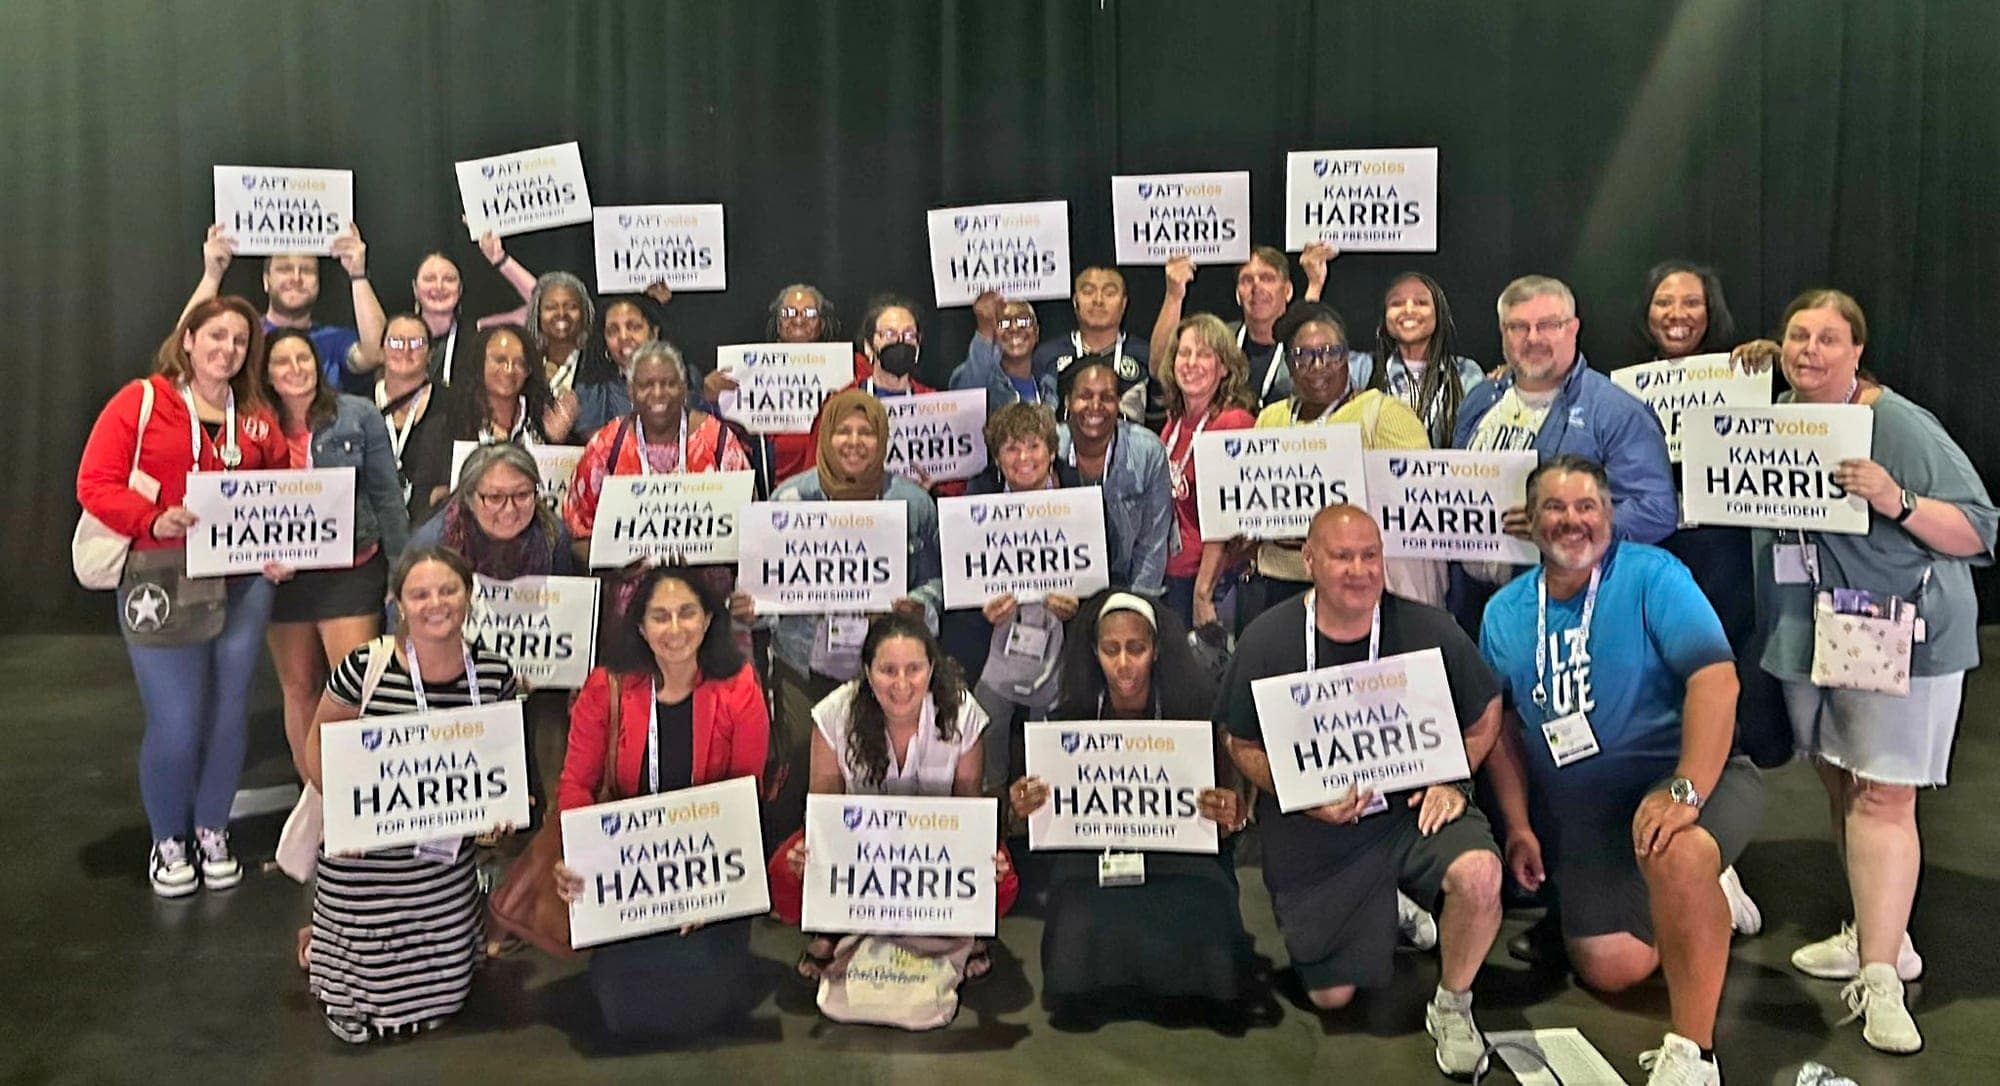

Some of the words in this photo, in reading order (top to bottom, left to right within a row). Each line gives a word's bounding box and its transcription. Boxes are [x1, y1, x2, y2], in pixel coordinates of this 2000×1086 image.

[1331, 159, 1405, 176] AFTvotes
[259, 176, 326, 190] AFTvotes
[496, 175, 554, 196] KAMALA
[1156, 183, 1222, 198] AFTvotes
[1324, 183, 1398, 200] KAMALA
[253, 196, 321, 210] KAMALA
[482, 182, 576, 218] HARRIS
[235, 210, 339, 235] HARRIS
[1150, 204, 1217, 221] KAMALA
[1305, 200, 1420, 226] HARRIS
[1133, 217, 1237, 243] HARRIS
[1318, 230, 1339, 242] FOR
[1342, 230, 1401, 242] PRESIDENT
[250, 236, 270, 247] FOR
[273, 236, 325, 247] PRESIDENT
[630, 234, 694, 248] KAMALA
[967, 236, 1036, 255] KAMALA
[1147, 245, 1167, 257] FOR
[1168, 244, 1222, 257] PRESIDENT
[614, 246, 712, 271] HARRIS
[950, 250, 1056, 282] HARRIS
[761, 351, 826, 366] AFTvotes
[755, 373, 821, 387] KAMALA
[1653, 365, 1735, 386] AFTvotes
[737, 388, 823, 411] HARRI
[888, 401, 959, 417] AFTvotes
[751, 414, 770, 425] FOR
[1736, 417, 1829, 436] AFTvotes
[893, 421, 952, 439] AMALA
[887, 433, 973, 463] ARRIS
[1247, 438, 1328, 454] AFTvotes
[1729, 446, 1821, 467] KAMALA
[1240, 463, 1322, 483] KAMALA
[1411, 460, 1501, 478] AFTvotes
[243, 480, 323, 496] AFTvotes
[650, 482, 723, 496] AFTvotes
[1706, 466, 1848, 500] HARRIS
[1404, 487, 1494, 505] KAMALA
[234, 503, 316, 521] KAMALA
[639, 501, 713, 516] KAMALA
[992, 503, 1071, 520] AFTvotes
[1727, 501, 1753, 514] FOR
[1756, 503, 1828, 518] PRESIDENT
[614, 514, 733, 541] HARRIS
[794, 512, 874, 529] AFTvotes
[1238, 516, 1262, 529] FOR
[1382, 505, 1498, 535] HARRI
[211, 518, 338, 548] HARRIS
[986, 527, 1067, 548] KAMALA
[628, 543, 650, 556] FOR
[654, 542, 714, 555] PRESIDENT
[786, 538, 867, 556] KAMALA
[1402, 537, 1427, 550] FOR
[1430, 538, 1501, 552] PRESIDENT
[228, 552, 252, 563] FOR
[256, 548, 319, 561] PRESIDENT
[965, 544, 1091, 579] HARRIS
[762, 556, 890, 585] HARRIS
[478, 585, 561, 603] AFTvotes
[985, 580, 1008, 594] FOR
[1011, 576, 1073, 591] PRESIDENT
[780, 590, 804, 602] FOR
[807, 589, 871, 602] PRESIDENT
[472, 630, 573, 659] ARRIS
[1316, 671, 1408, 702] AFTvotes
[1313, 702, 1409, 734] KAMALA
[388, 721, 485, 747] AFTvotes
[1084, 732, 1176, 752] AFTvotes
[1293, 716, 1442, 774] HARRIS
[380, 751, 478, 781] KAMALA
[1078, 763, 1170, 784] KAMALA
[1322, 773, 1350, 789] FOR
[1353, 759, 1425, 783] PRESIDENT
[353, 766, 508, 818] HARRIS
[1054, 785, 1198, 818] HARRIS
[376, 818, 407, 836] FOR
[410, 808, 486, 831] PRESIDENT
[626, 801, 721, 833] AFTvotes
[867, 809, 960, 831] AFTvotes
[1074, 822, 1100, 836] FOR
[1103, 822, 1177, 838] PRESIDENT
[620, 831, 715, 865] KAMALA
[857, 841, 950, 864] KAMALA
[596, 848, 746, 906] HARRIS
[829, 863, 977, 899] HARRIS
[619, 905, 648, 922] FOR
[651, 891, 726, 917] PRESIDENT
[849, 904, 876, 920] FOR
[880, 904, 953, 921] PRESIDENT
